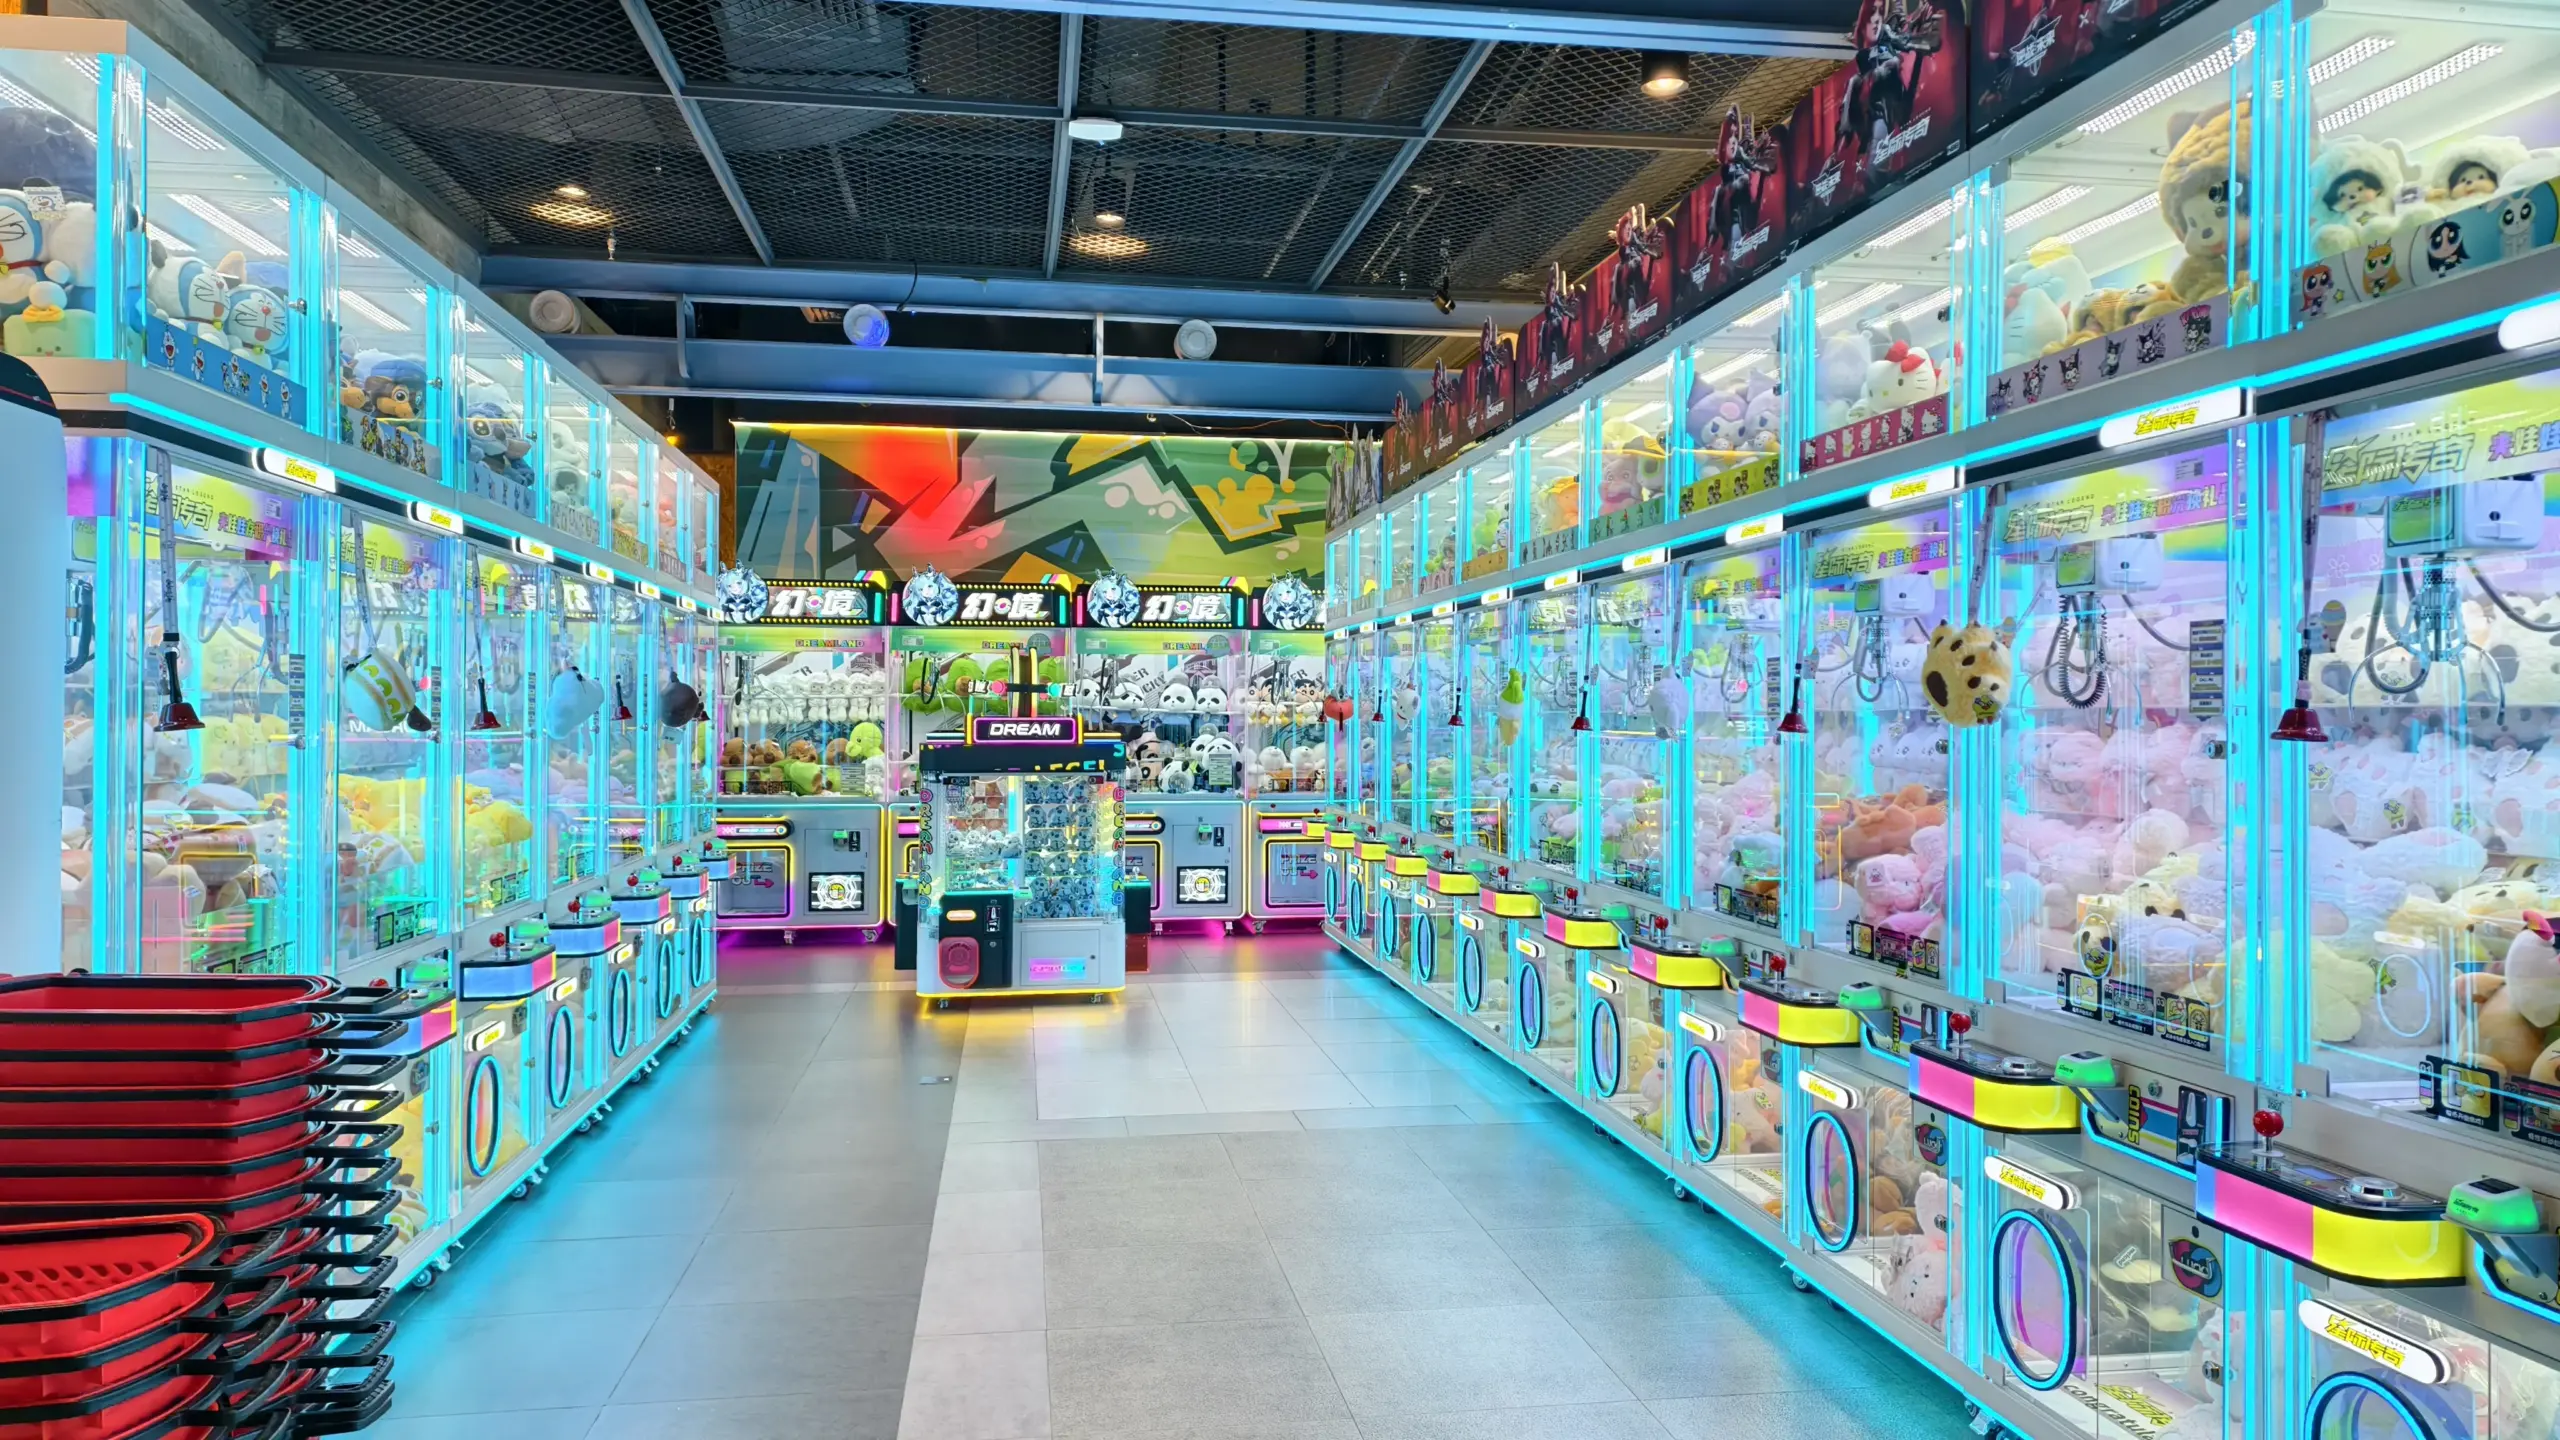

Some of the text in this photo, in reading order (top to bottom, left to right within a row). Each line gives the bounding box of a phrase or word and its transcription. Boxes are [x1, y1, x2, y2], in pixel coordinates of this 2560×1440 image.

[2134, 407, 2199, 436] 星际传奇
[2322, 433, 2475, 491] 星际传奇
[2003, 503, 2095, 544] 星际传奇
[795, 638, 865, 648] DREAMLAND
[989, 722, 1061, 737] DREAM
[2324, 1313, 2406, 1369] 星际传奇
